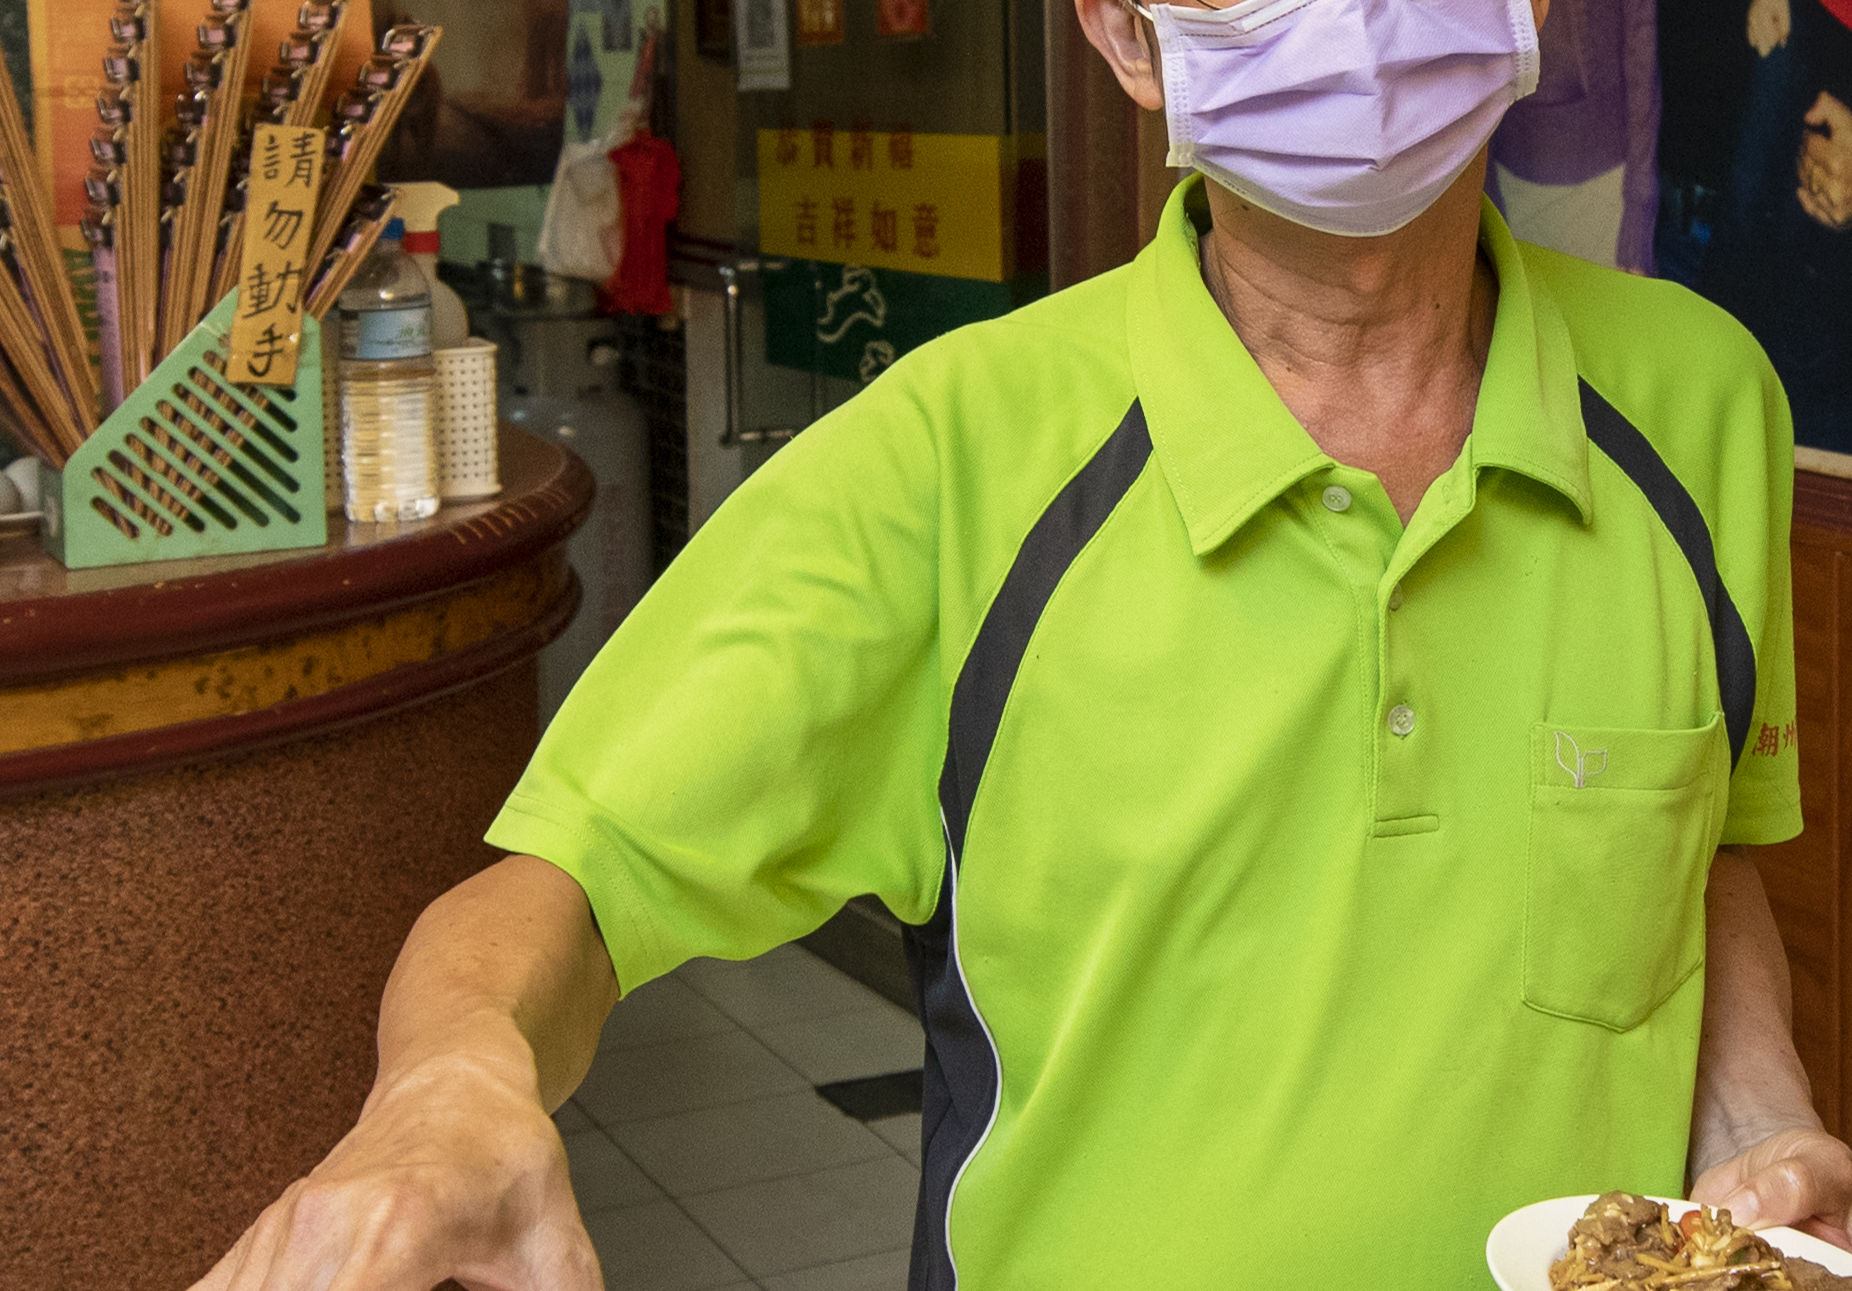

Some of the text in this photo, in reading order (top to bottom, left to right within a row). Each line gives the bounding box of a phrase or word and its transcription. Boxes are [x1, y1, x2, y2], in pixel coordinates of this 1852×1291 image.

[242, 131, 317, 378] 請勿動手
[795, 199, 940, 260] 吉祥如意
